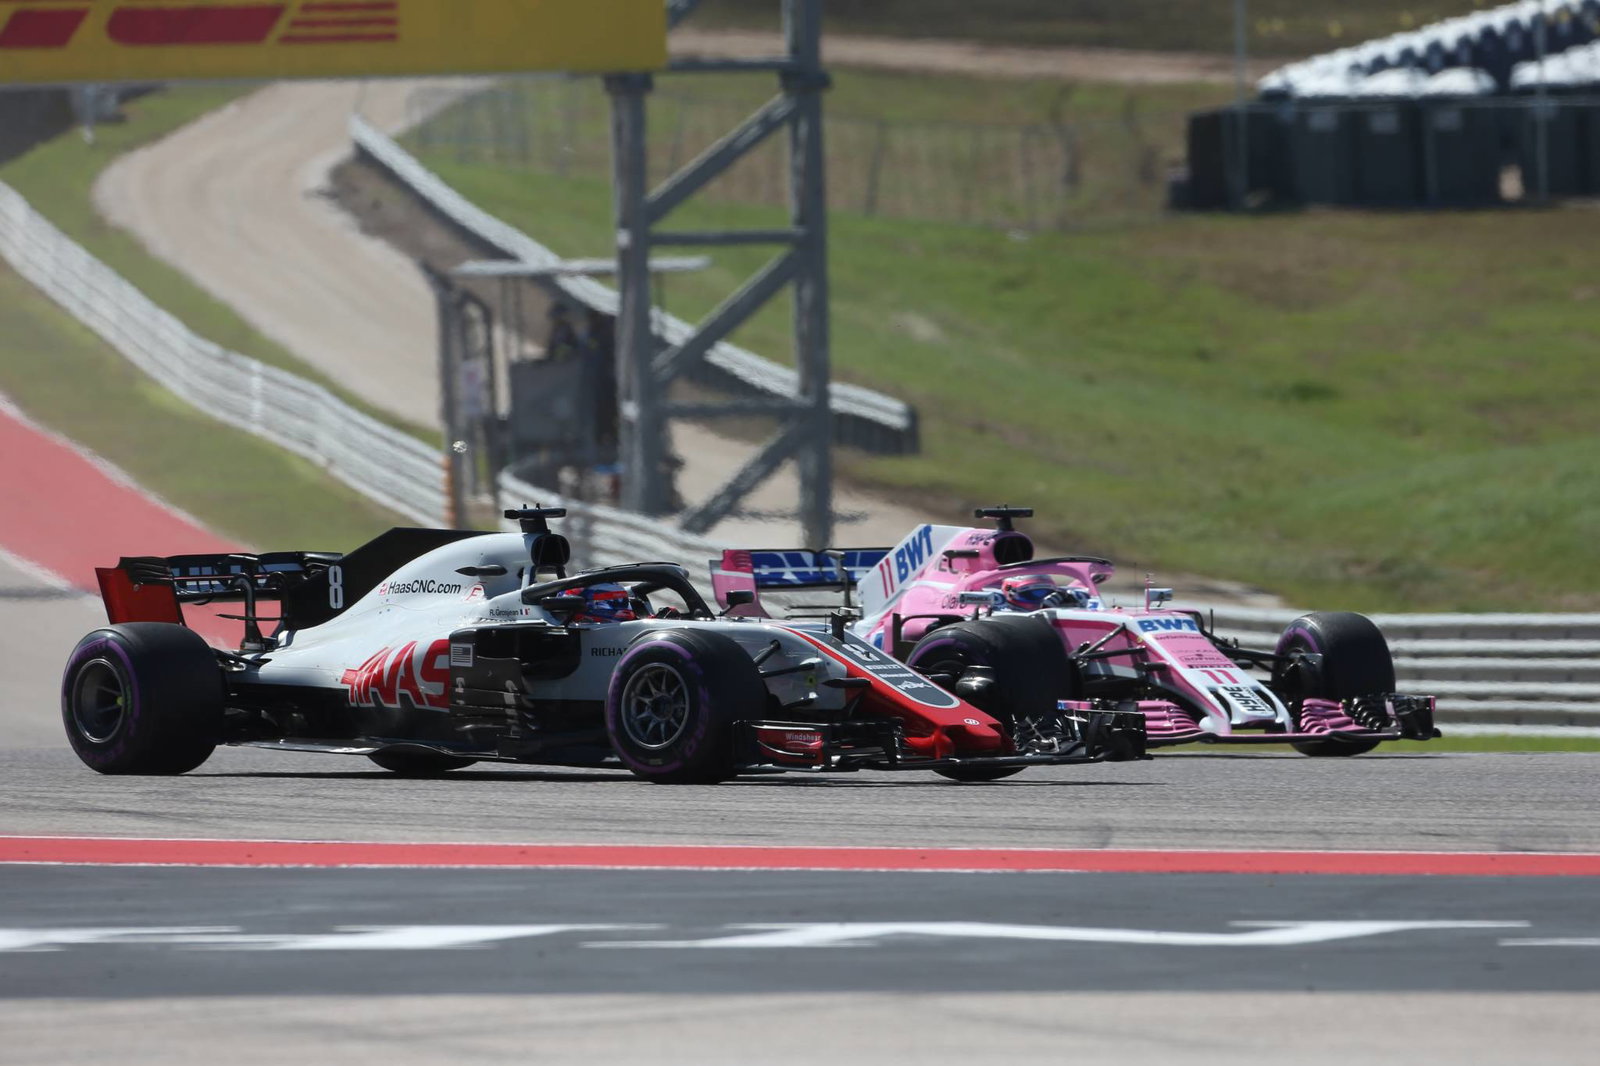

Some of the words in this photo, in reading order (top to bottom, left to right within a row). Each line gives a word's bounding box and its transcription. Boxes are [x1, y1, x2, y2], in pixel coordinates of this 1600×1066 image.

[879, 557, 895, 599] 11
[894, 525, 934, 584] BWT
[328, 565, 344, 609] 8
[387, 579, 461, 595] HaasCNC.com
[1137, 619, 1199, 633] BWT
[340, 638, 450, 712] HAAS
[1200, 669, 1240, 685] 11
[785, 732, 821, 741] Windshear
